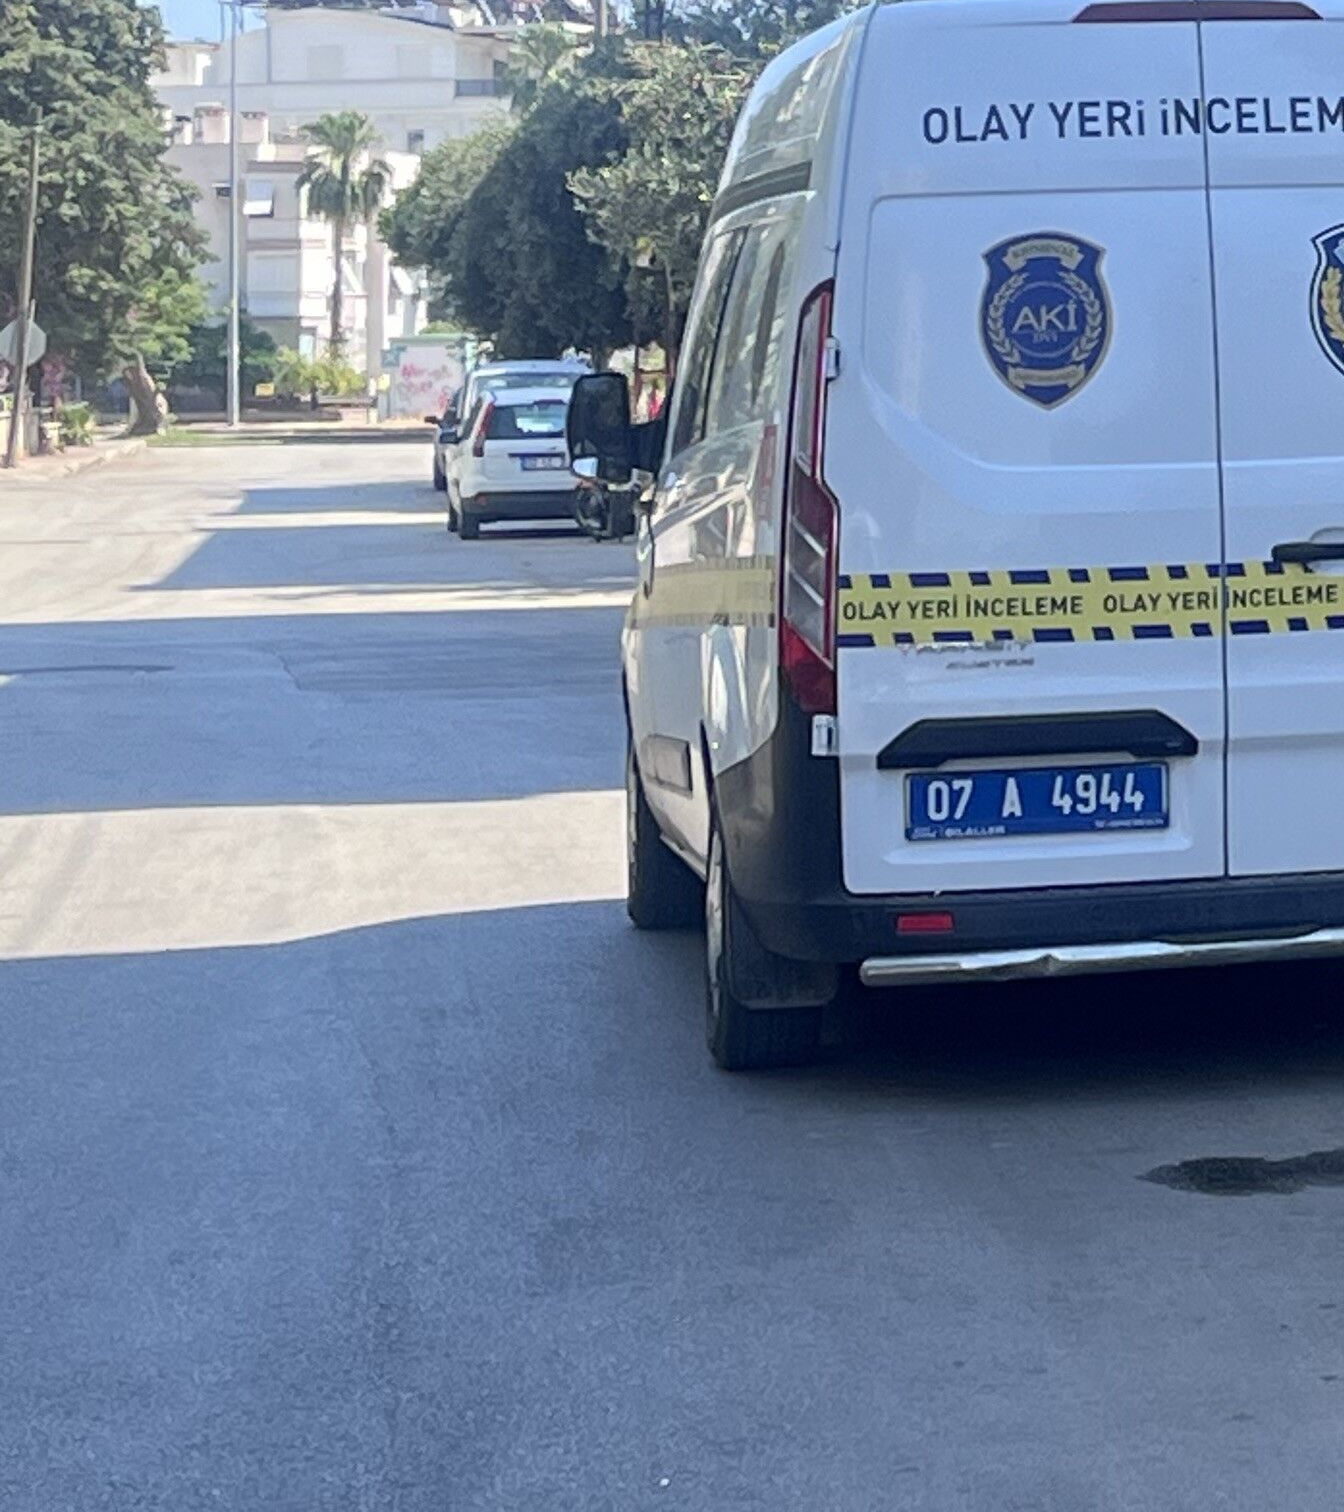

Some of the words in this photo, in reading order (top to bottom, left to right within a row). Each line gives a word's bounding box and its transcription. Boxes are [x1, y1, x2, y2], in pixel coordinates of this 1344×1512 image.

[922, 103, 1035, 144] OLAY
[842, 599, 900, 620] OLAY
[907, 594, 958, 619] YERİ
[965, 593, 1083, 618] İNCELEME
[1103, 592, 1162, 614] OLAY
[1167, 585, 1218, 611] YERİ
[927, 778, 973, 821] 07
[1001, 776, 1023, 818] A
[1051, 772, 1145, 815] 4944
